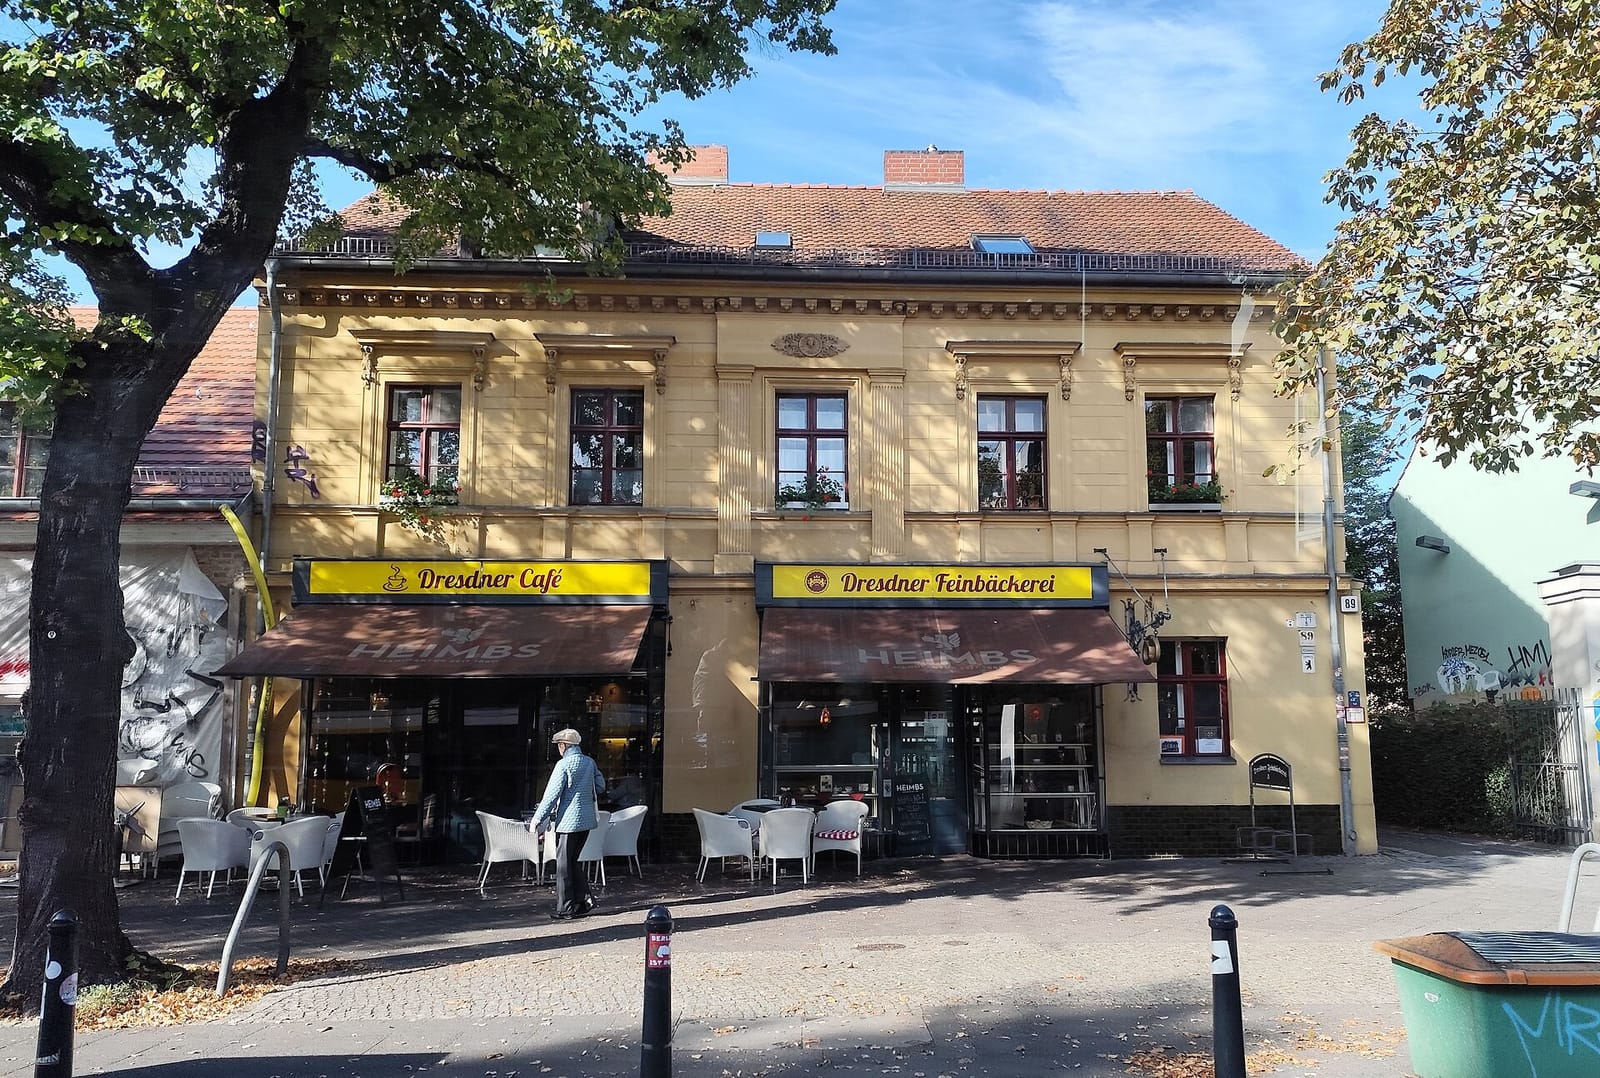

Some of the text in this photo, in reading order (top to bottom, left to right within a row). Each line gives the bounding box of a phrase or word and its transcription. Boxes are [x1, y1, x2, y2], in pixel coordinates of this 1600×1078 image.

[417, 568, 563, 594] Dresdner Café
[840, 572, 1056, 593] Dresdner Feinbäckerei
[1344, 598, 1356, 609] 89
[1300, 631, 1313, 641] 89
[347, 643, 541, 659] HEIMBS
[857, 649, 1039, 666] HEIMBS
[896, 783, 924, 792] HEIMBS
